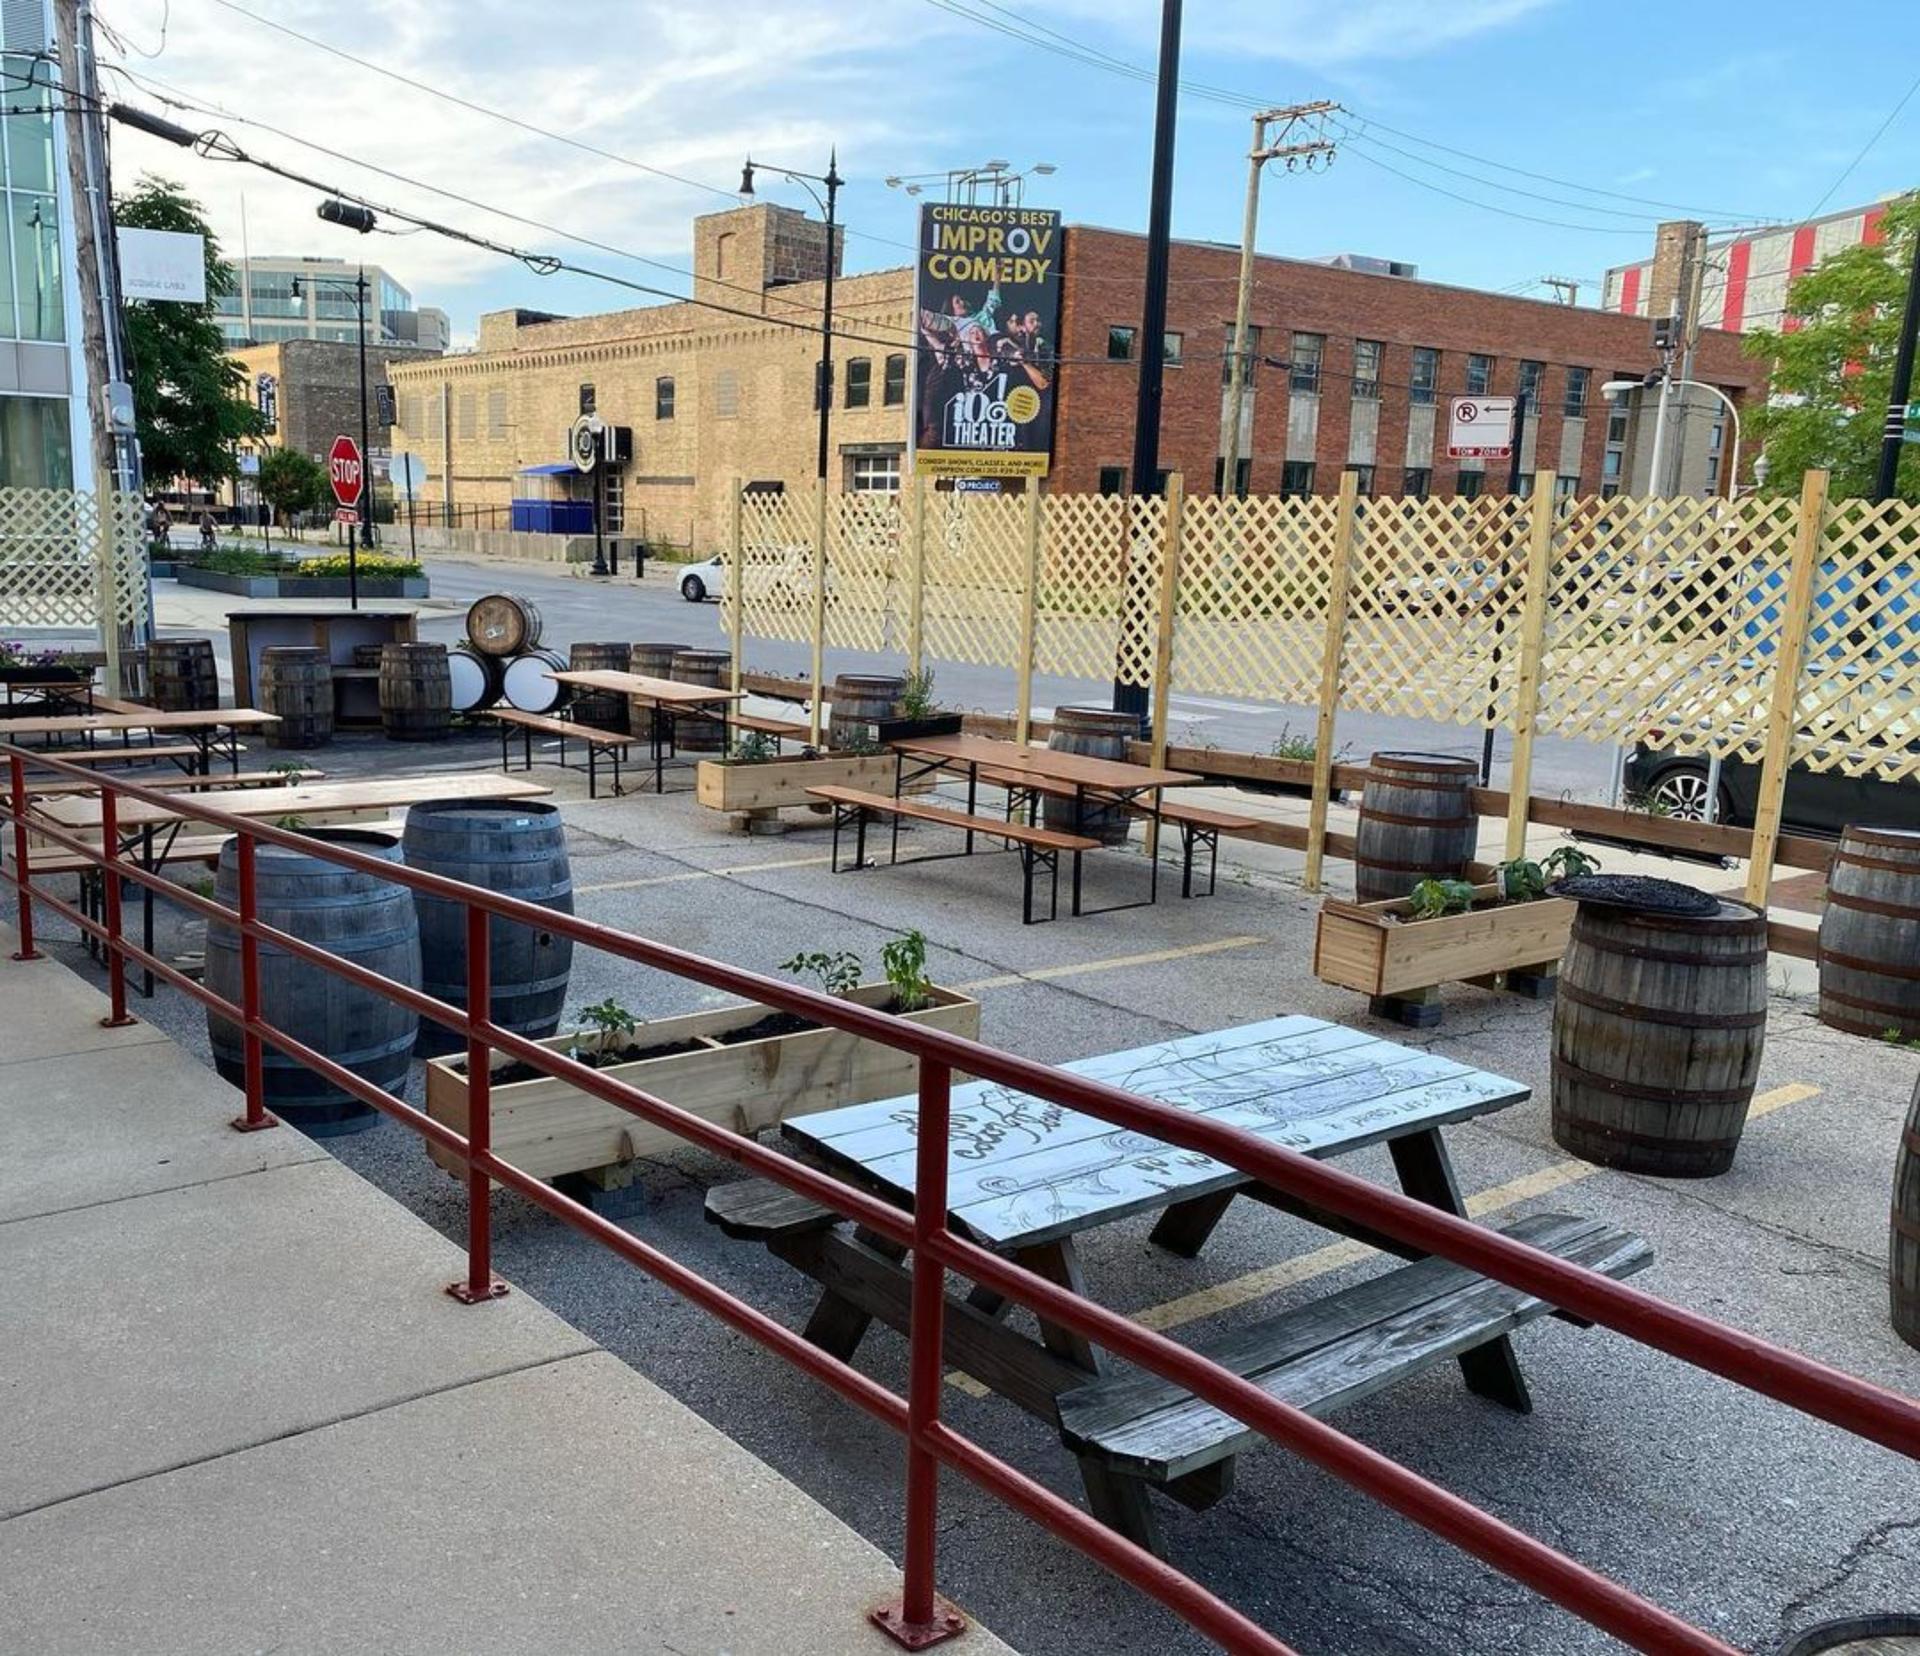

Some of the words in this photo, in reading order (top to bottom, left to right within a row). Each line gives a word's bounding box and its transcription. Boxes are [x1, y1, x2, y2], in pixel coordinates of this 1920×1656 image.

[932, 207, 1016, 225] CHICAGO'S
[1021, 211, 1055, 226] BEST
[932, 223, 1053, 255] IMPROV
[928, 254, 1052, 284] COMEDY
[953, 422, 1016, 447] THEATER
[1456, 447, 1475, 456] TOW
[1478, 447, 1503, 457] ZONE
[332, 457, 360, 485] STOP
